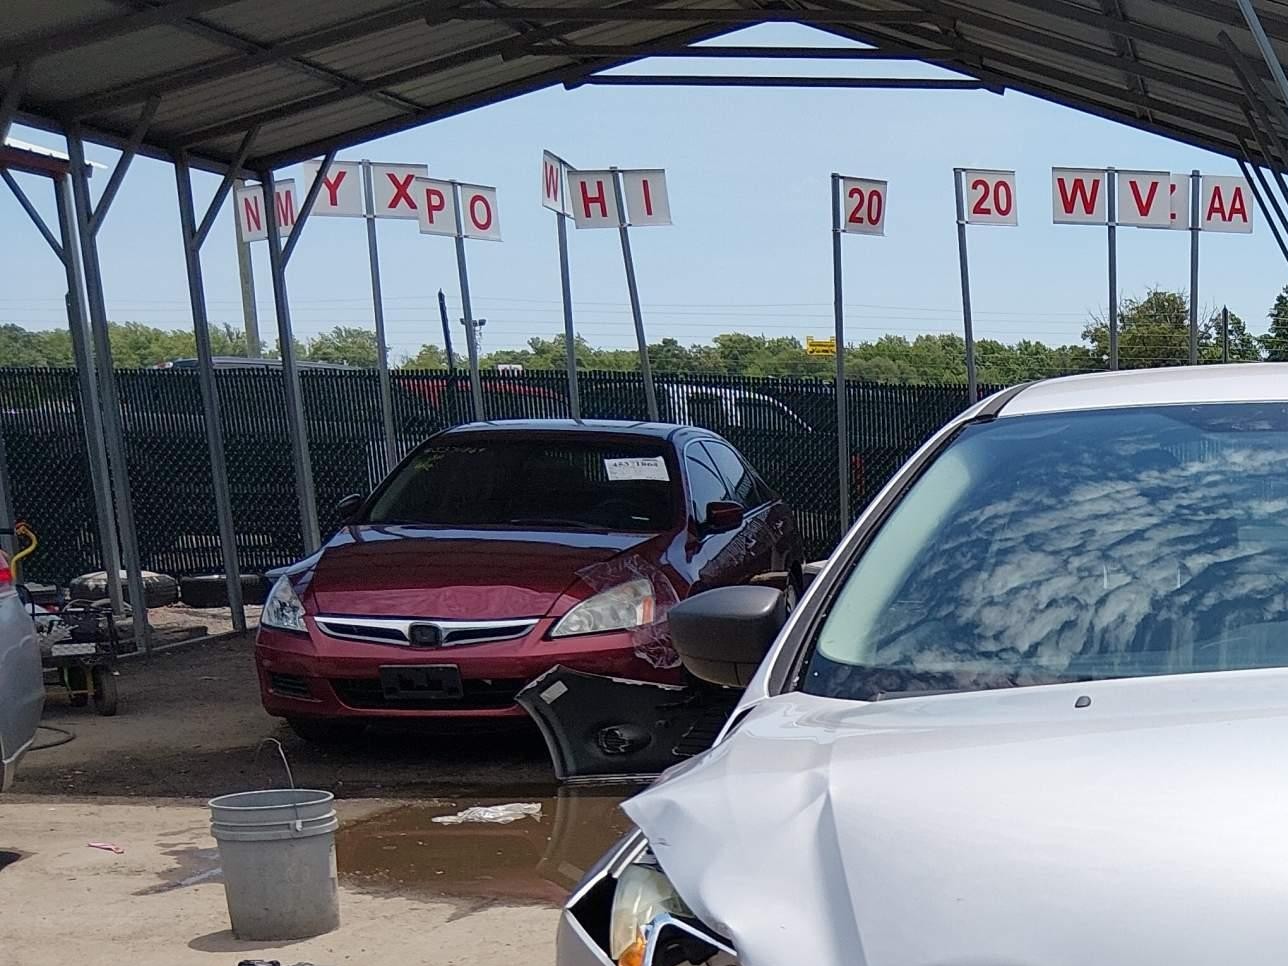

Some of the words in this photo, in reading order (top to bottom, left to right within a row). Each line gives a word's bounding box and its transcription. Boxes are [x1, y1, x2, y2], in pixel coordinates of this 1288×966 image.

[322, 170, 347, 207] Y
[386, 172, 417, 210] X
[544, 161, 558, 202] W
[580, 180, 608, 218] H
[642, 179, 653, 216] I
[971, 179, 1012, 217] 20
[1057, 177, 1100, 215] W
[1129, 180, 1159, 217] V
[244, 196, 261, 232] N
[275, 190, 294, 227] M
[425, 188, 445, 224] P
[469, 194, 492, 231] O
[848, 187, 883, 226] 20
[1206, 185, 1248, 223] AA
